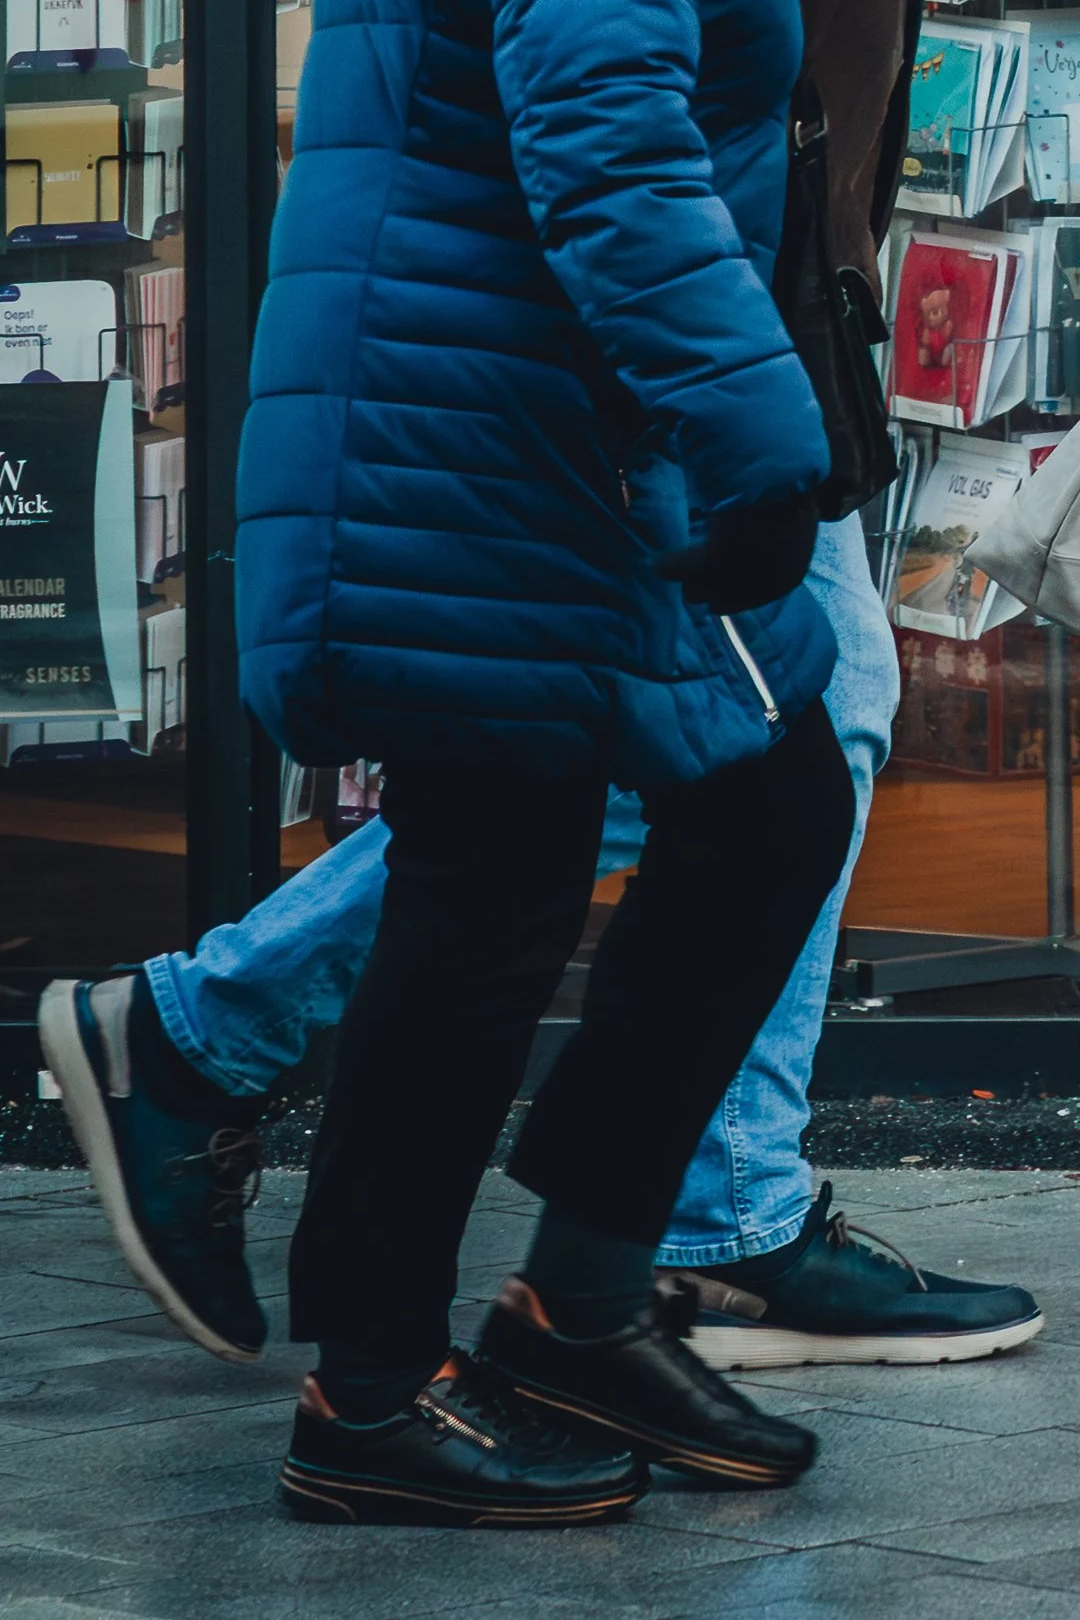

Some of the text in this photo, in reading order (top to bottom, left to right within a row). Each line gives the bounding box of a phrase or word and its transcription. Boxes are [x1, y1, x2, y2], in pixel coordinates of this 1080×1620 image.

[4, 309, 34, 322] Oeps!
[15, 324, 35, 334] ben
[37, 324, 48, 333] er
[5, 337, 53, 348] even net
[948, 474, 993, 500] VOL GAS
[25, 666, 93, 685] SENSES
